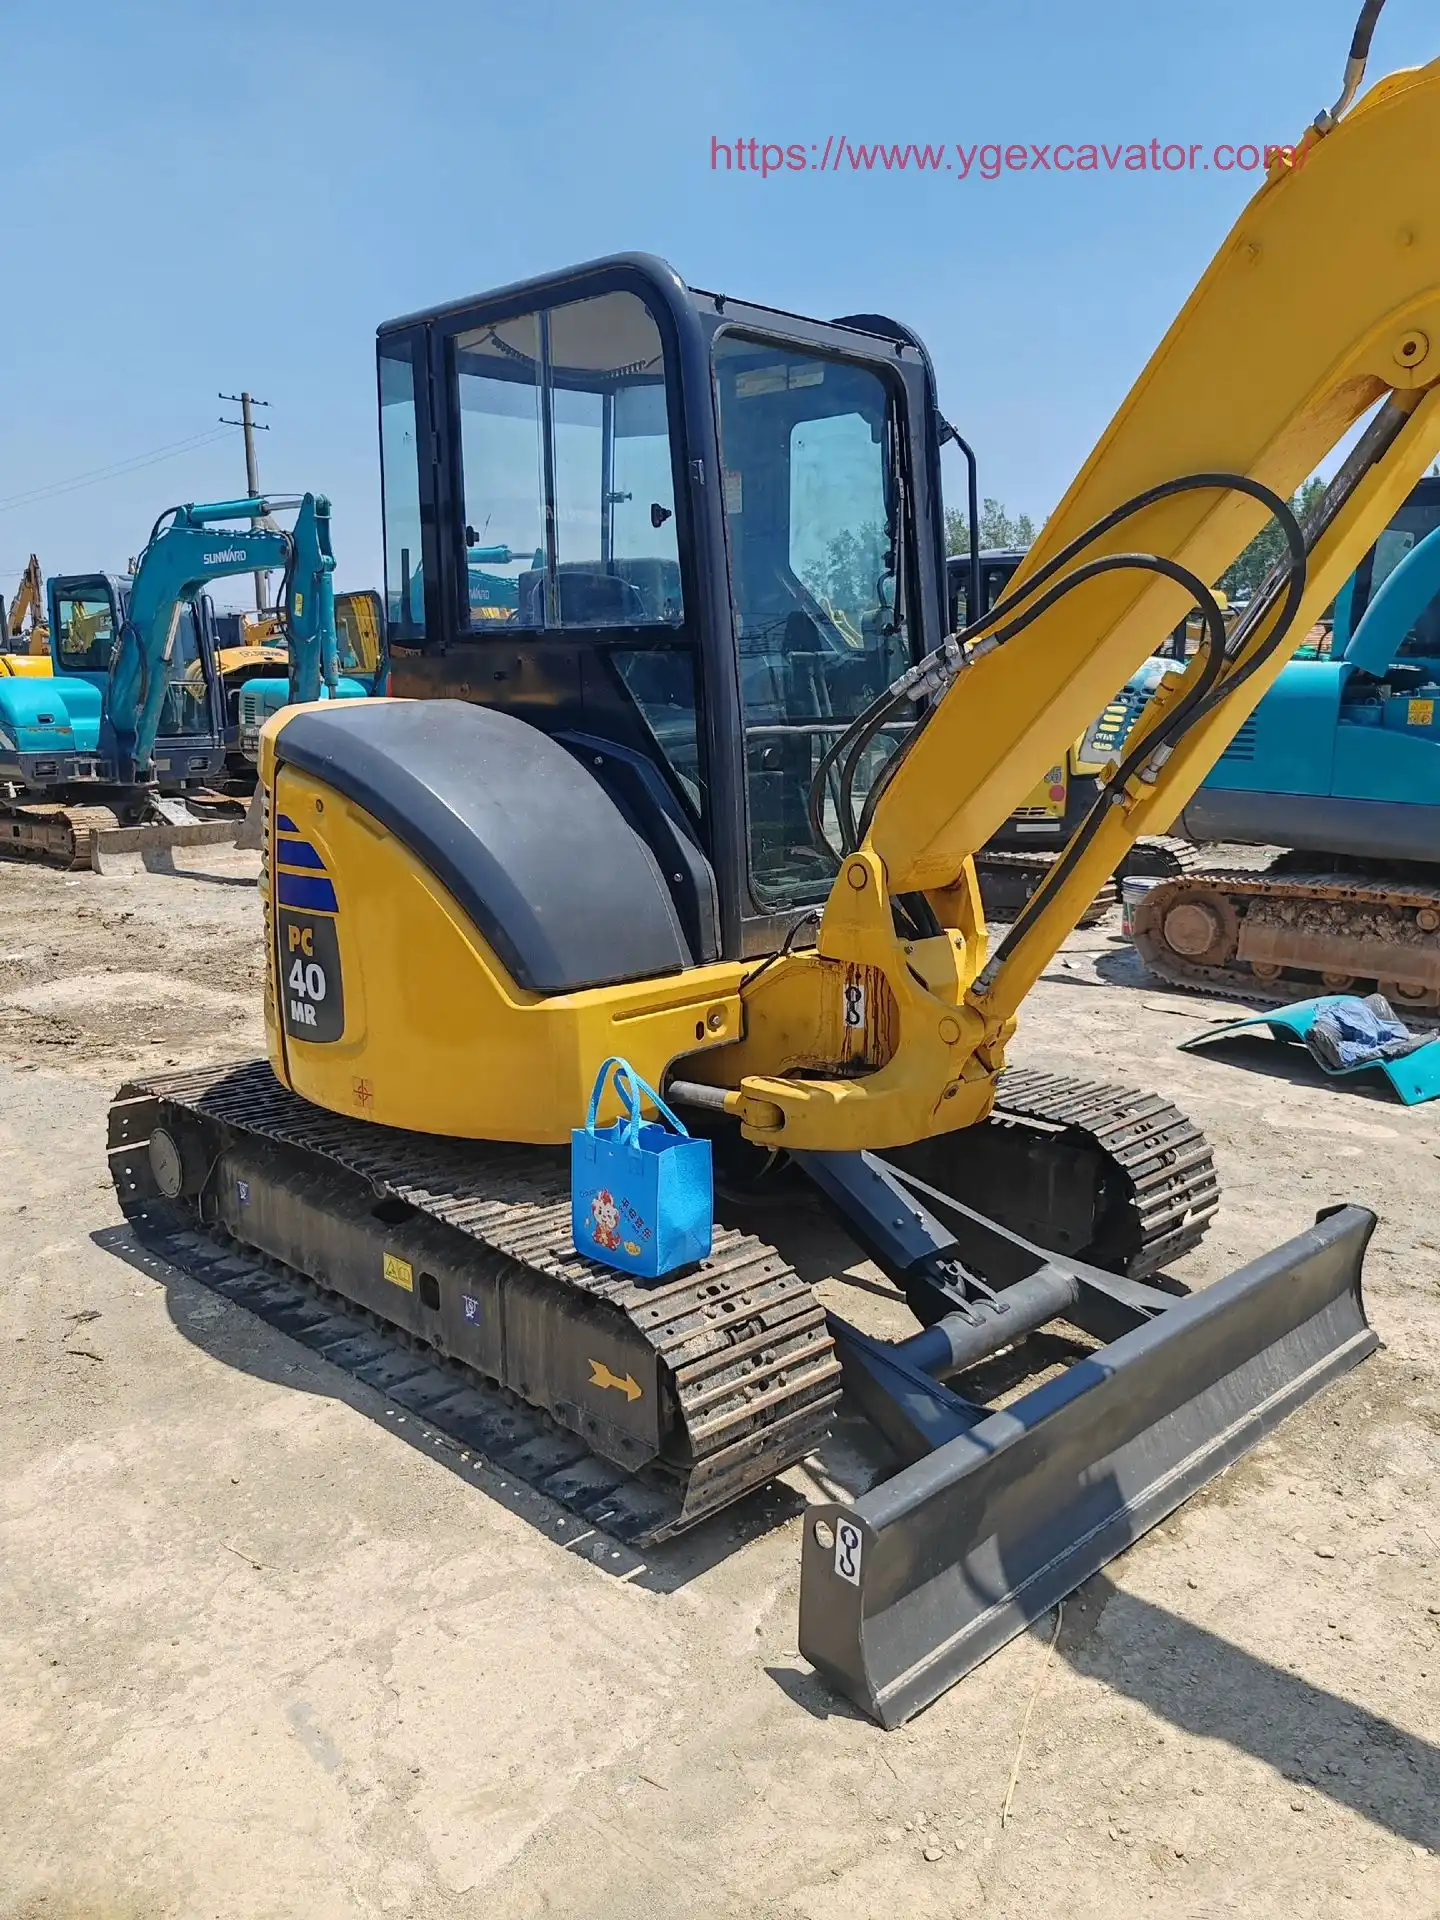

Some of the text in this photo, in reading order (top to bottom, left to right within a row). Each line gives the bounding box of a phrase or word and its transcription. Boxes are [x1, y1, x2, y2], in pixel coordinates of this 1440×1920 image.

[203, 544, 247, 565] SUNWARD
[288, 924, 313, 957] PC
[288, 958, 326, 1001] 40
[290, 999, 318, 1027] MR
